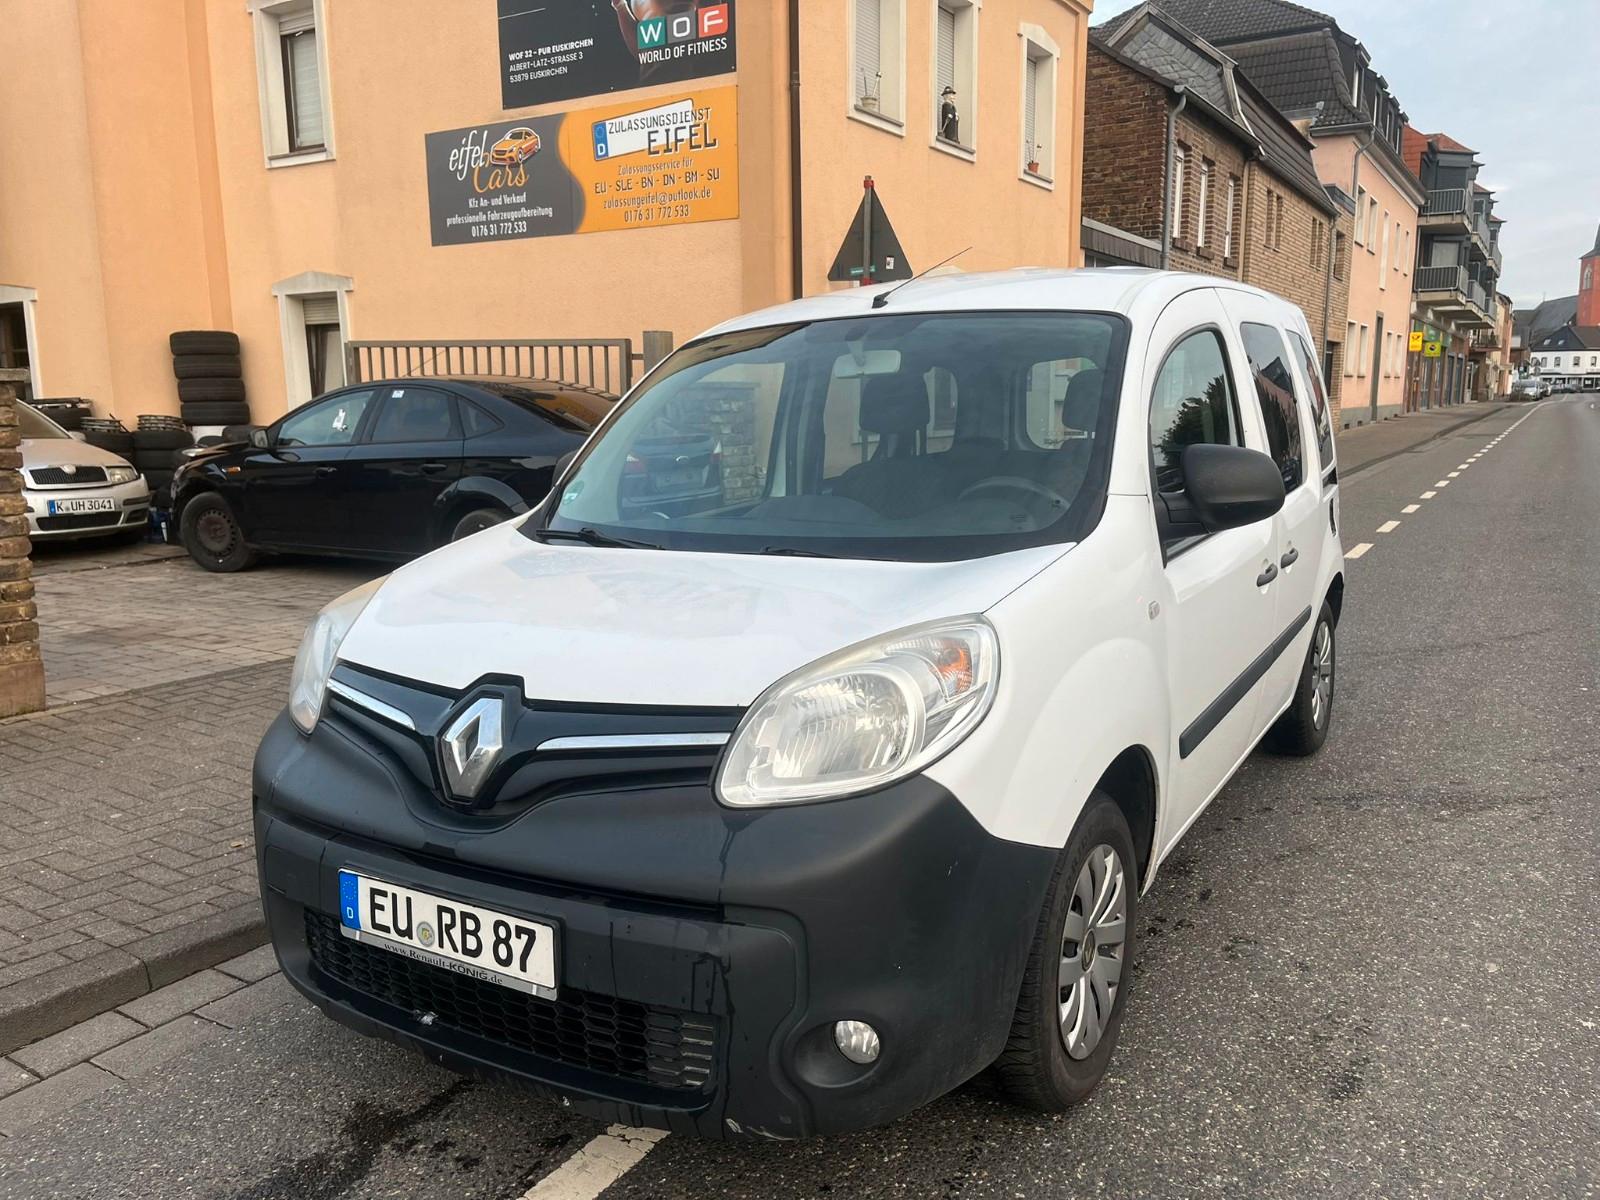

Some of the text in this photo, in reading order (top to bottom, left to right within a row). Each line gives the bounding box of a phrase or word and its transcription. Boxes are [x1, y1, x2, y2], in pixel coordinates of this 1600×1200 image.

[640, 10, 724, 44] WOF
[508, 52, 524, 61] WOF
[538, 46, 551, 56] PUR
[552, 38, 594, 53] EUSKIRCHEN
[638, 37, 727, 65] WORLD OF FITNESS
[509, 51, 583, 72] ALBERT-LATZ-STRASSE 3
[509, 66, 568, 83] 53879 EUSKIRCHEN
[608, 107, 712, 134] ZULASSUNGSDIENST
[597, 143, 606, 156] D
[647, 122, 718, 156] EIFEL
[448, 130, 488, 181] eifel
[618, 159, 680, 176] Zulassungsservice
[595, 182, 607, 194] EU
[615, 179, 633, 192] SLE
[641, 177, 654, 189] BN
[663, 173, 676, 186] DN
[685, 171, 698, 183] BM
[707, 168, 720, 180] SU
[468, 198, 479, 208] Kfz
[491, 195, 502, 206] und
[503, 192, 527, 204] Verkauf
[603, 186, 711, 209] zulassungeifel@outlook.de
[446, 206, 553, 227] professionelle Fahrzeugaufbereitung
[624, 204, 689, 223] 0176 31 772 533
[471, 221, 527, 237] 0176 31 772 533
[56, 501, 63, 512] K
[70, 500, 85, 512] UH
[87, 499, 113, 511] 3041
[346, 906, 354, 919] D
[369, 886, 537, 973] EU RB 87
[384, 942, 503, 985] www.Renault-KÖNIG.de
